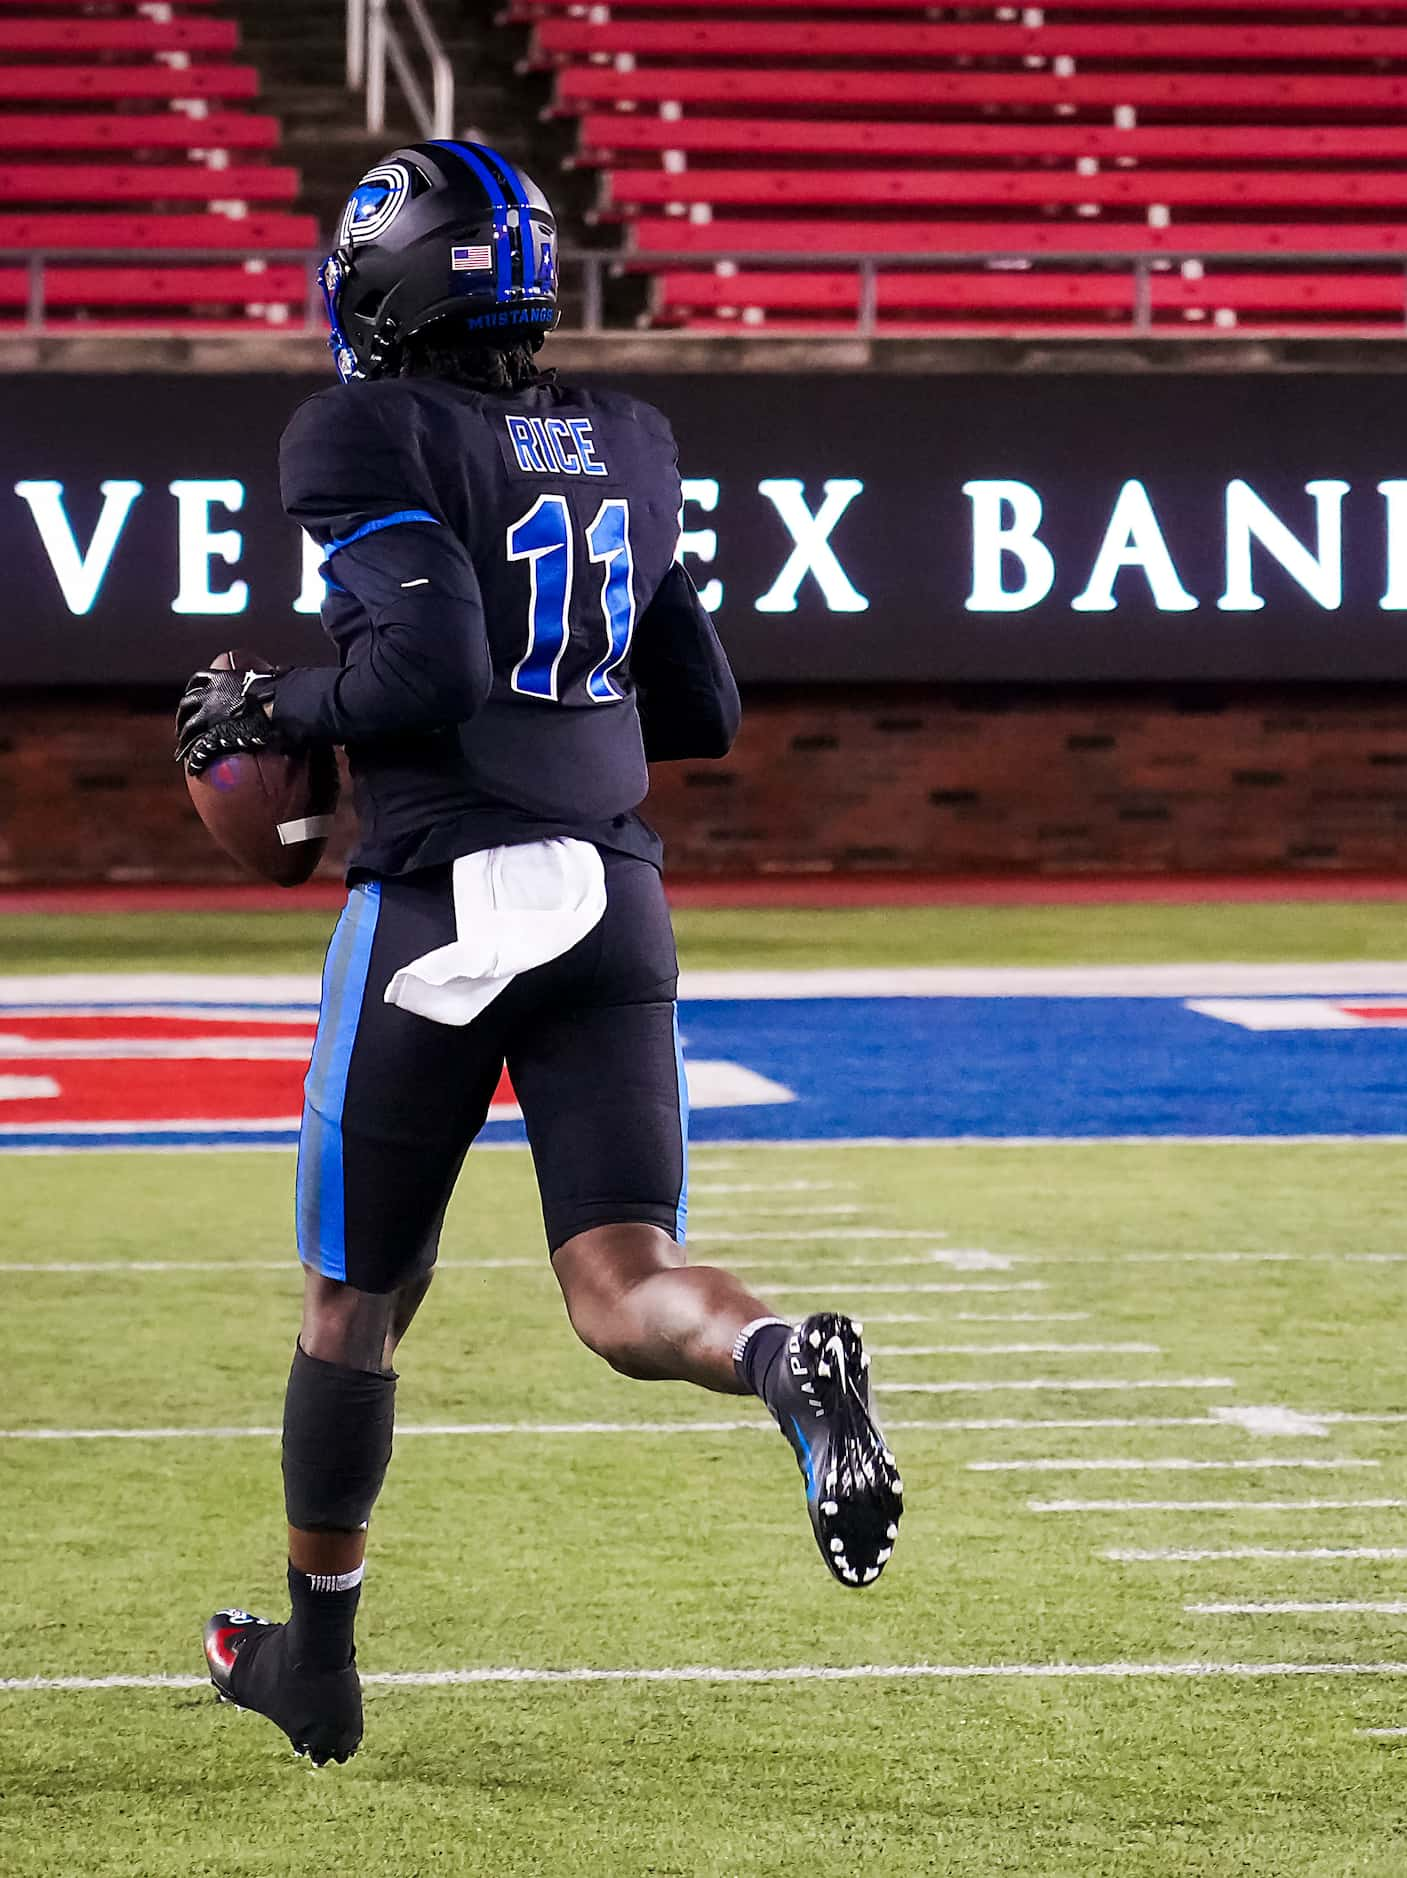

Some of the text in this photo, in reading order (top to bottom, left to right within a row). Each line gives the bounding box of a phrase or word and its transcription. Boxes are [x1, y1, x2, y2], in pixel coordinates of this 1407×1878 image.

[468, 307, 554, 331] MUSTANGS
[505, 414, 609, 476] RICE
[507, 494, 636, 703] 11
